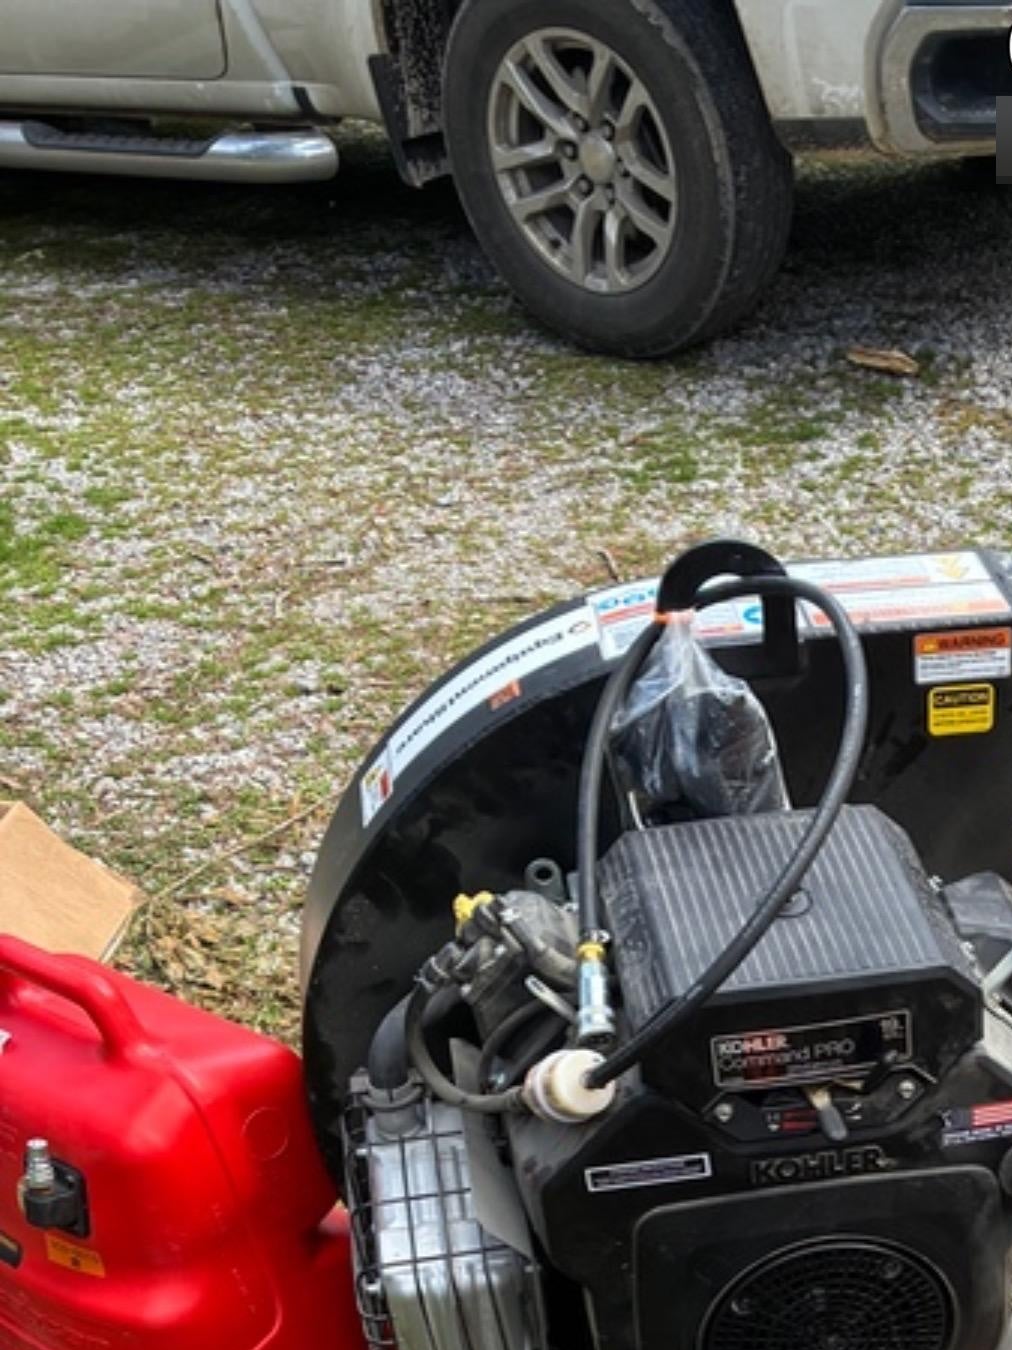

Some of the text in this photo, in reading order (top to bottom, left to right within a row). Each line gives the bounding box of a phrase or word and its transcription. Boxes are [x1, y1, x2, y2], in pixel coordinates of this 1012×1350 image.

[718, 1034, 790, 1055] KOHLER
[718, 1045, 811, 1071] Command
[813, 1037, 857, 1058] PRO
[750, 1145, 886, 1185] KOHLER
